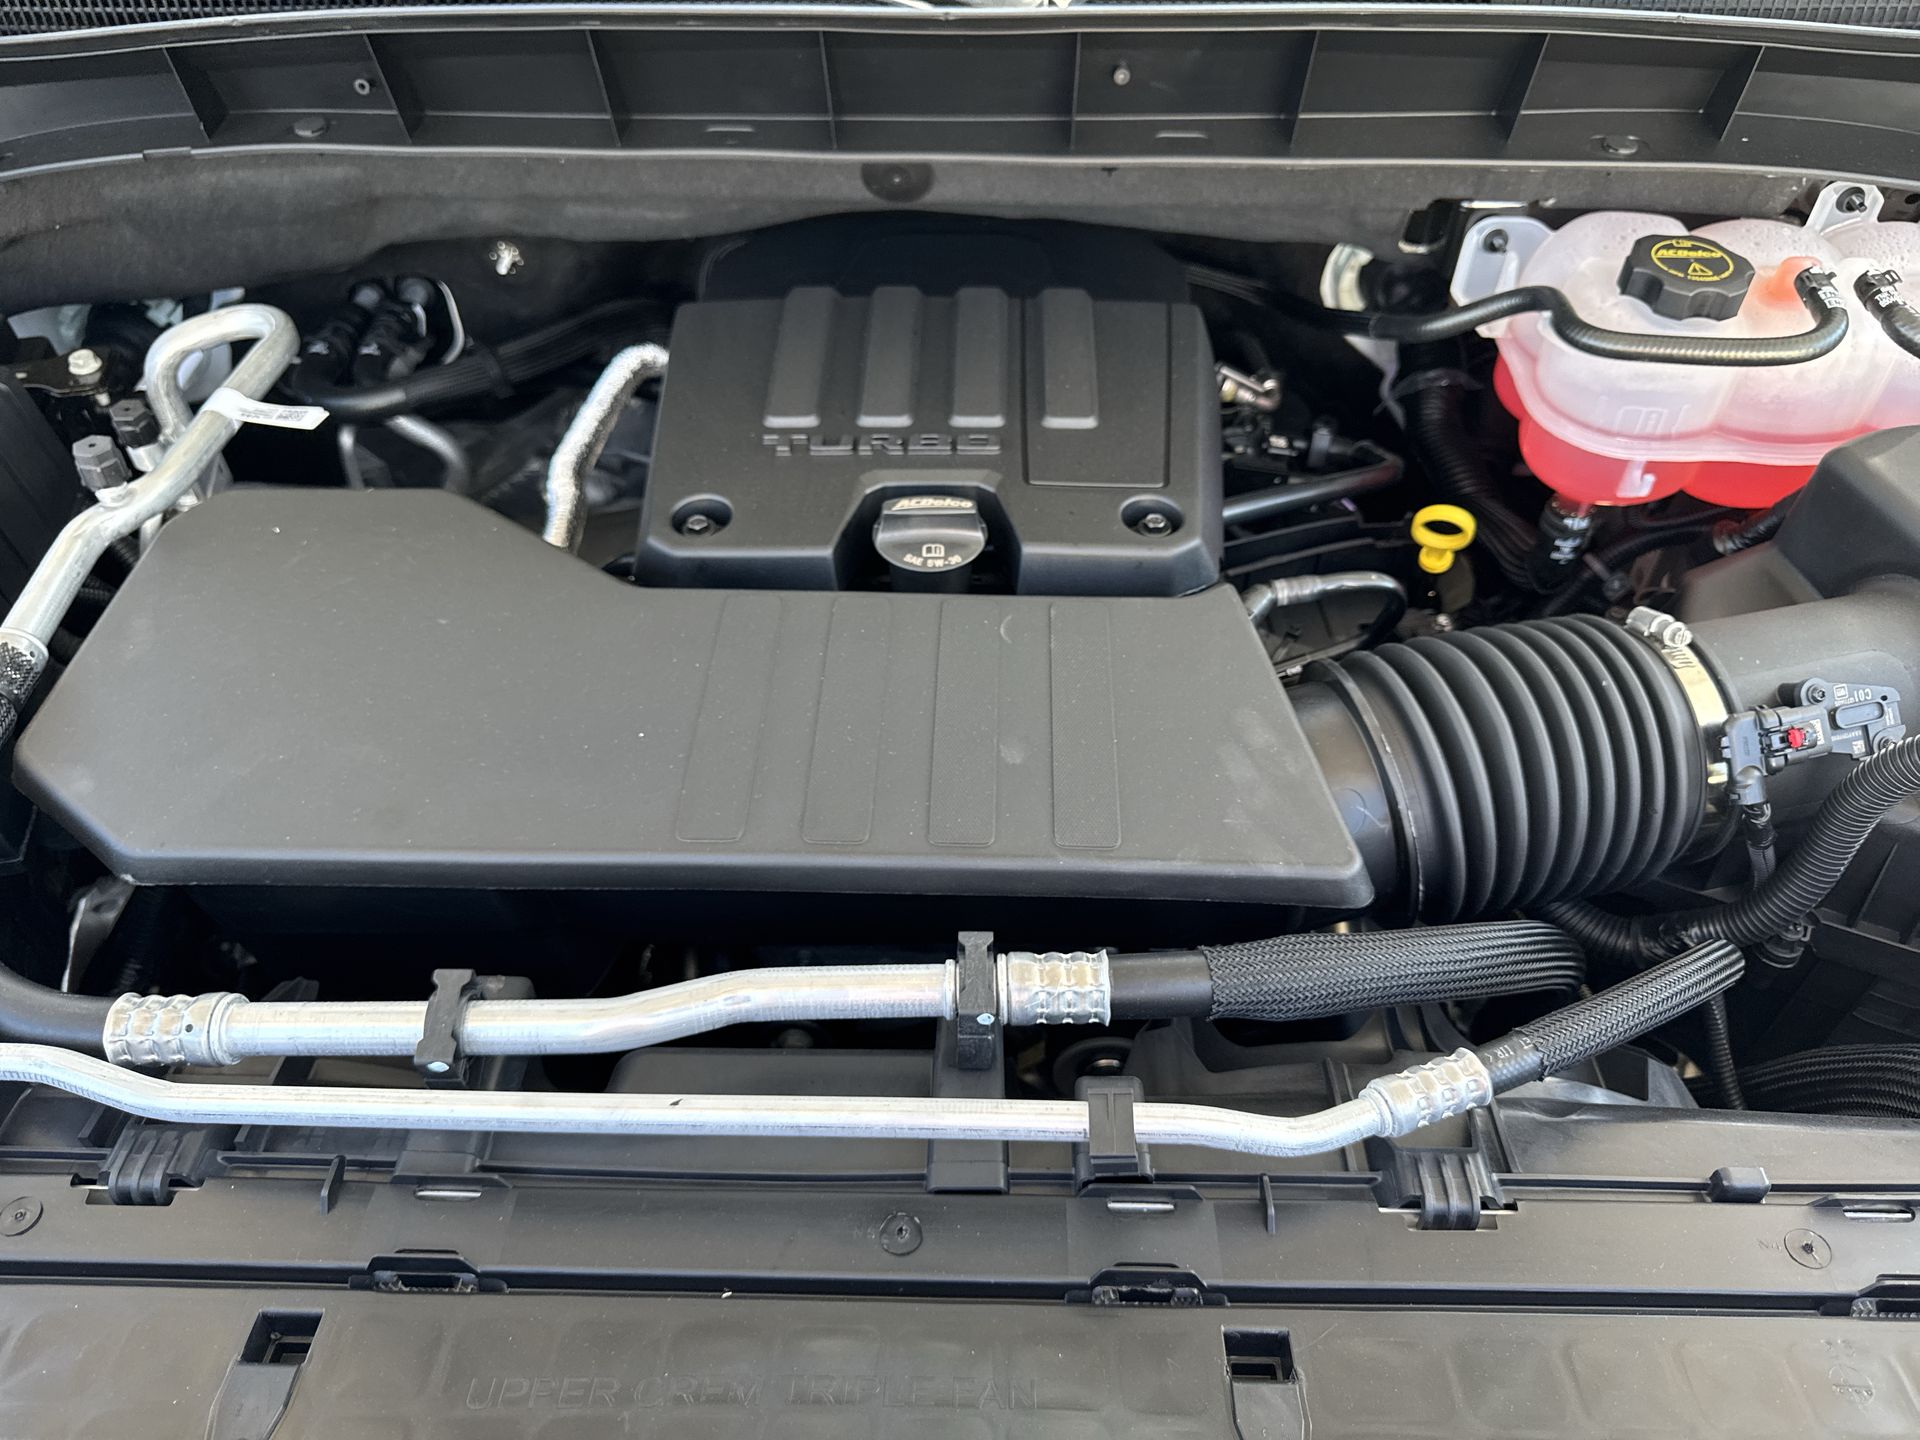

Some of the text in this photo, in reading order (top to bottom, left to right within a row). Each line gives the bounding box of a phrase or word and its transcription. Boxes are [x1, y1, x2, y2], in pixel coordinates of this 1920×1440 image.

[1655, 248, 1723, 258] ACDelco
[763, 434, 1001, 456] TURBO
[893, 497, 973, 511] ACDelco
[903, 553, 963, 568] SAE 5W-30
[466, 1376, 623, 1411] UPPER
[777, 1374, 937, 1409] TRIPLE
[951, 1375, 1038, 1411] FAN
